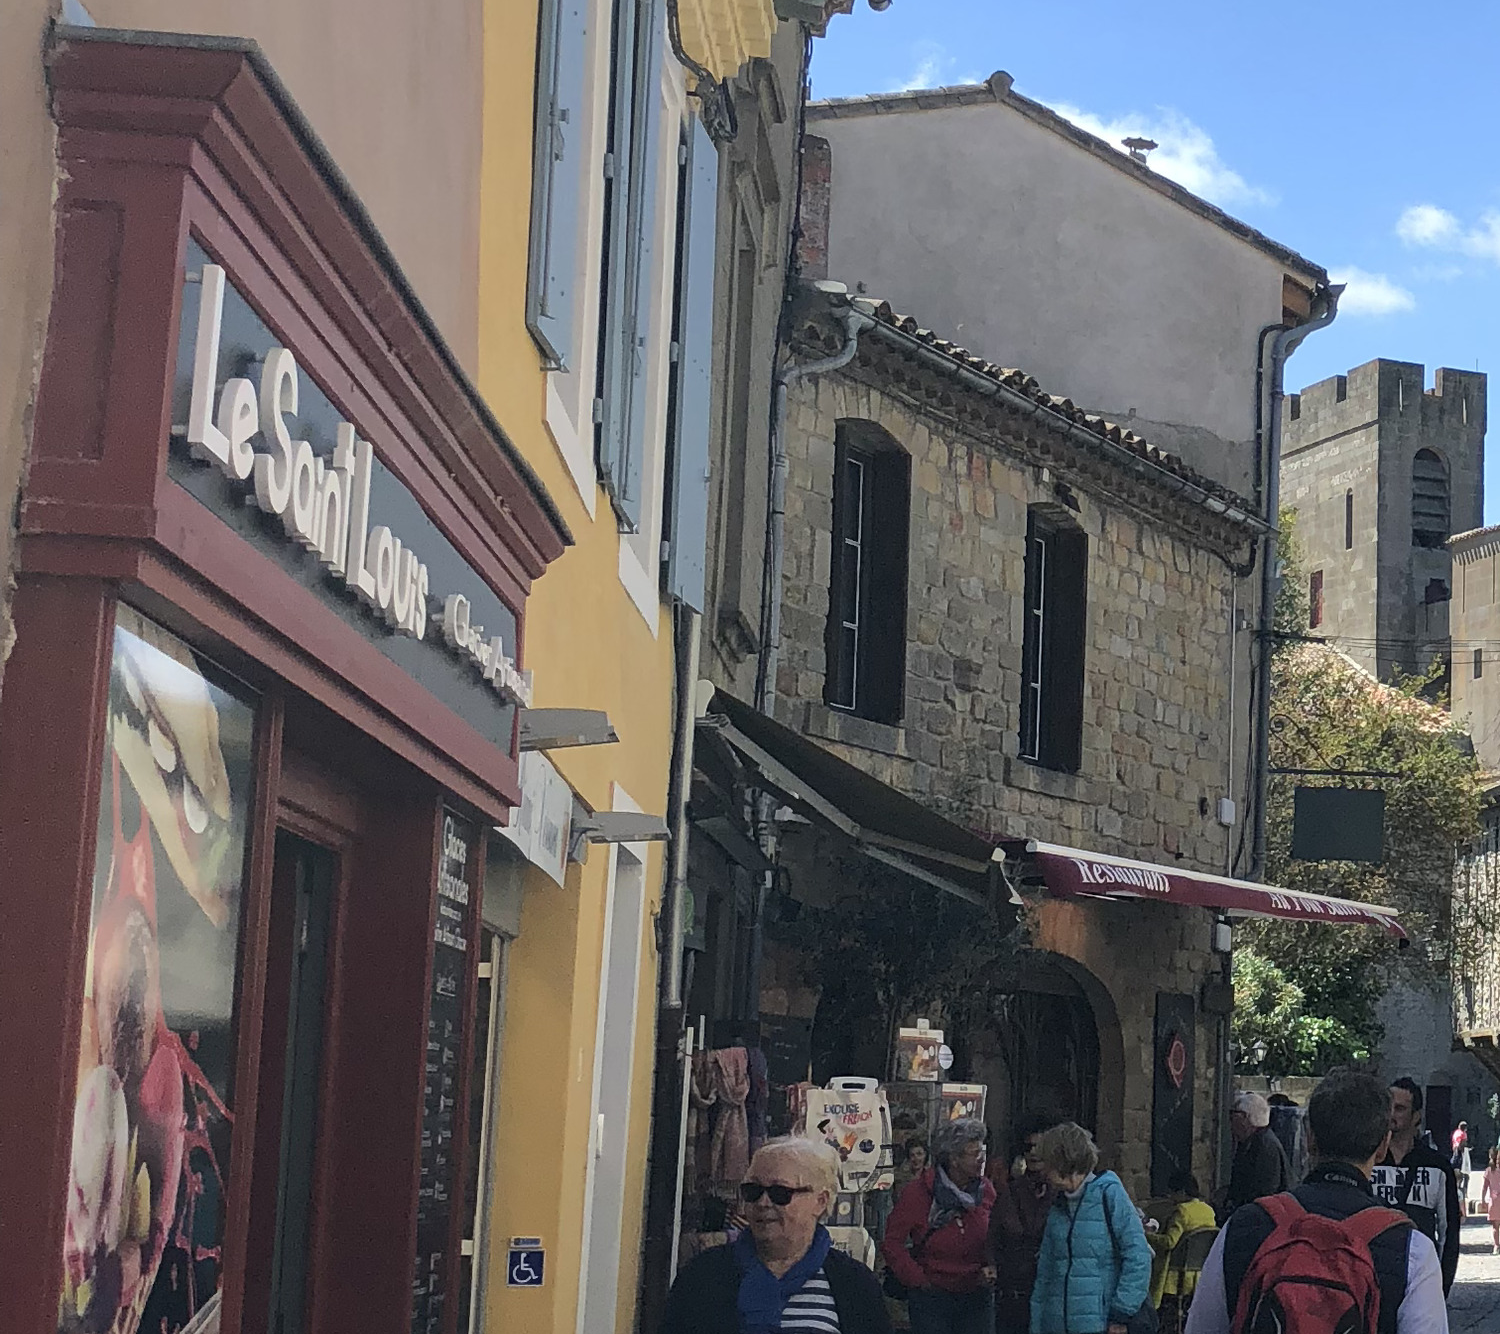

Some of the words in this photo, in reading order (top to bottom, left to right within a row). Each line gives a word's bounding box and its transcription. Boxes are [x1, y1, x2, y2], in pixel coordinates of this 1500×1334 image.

[187, 264, 259, 480] Le
[254, 347, 356, 578] Saint
[346, 441, 429, 641] Louis
[1073, 859, 1171, 894] Restaurant
[824, 1103, 860, 1115] EXCUSE
